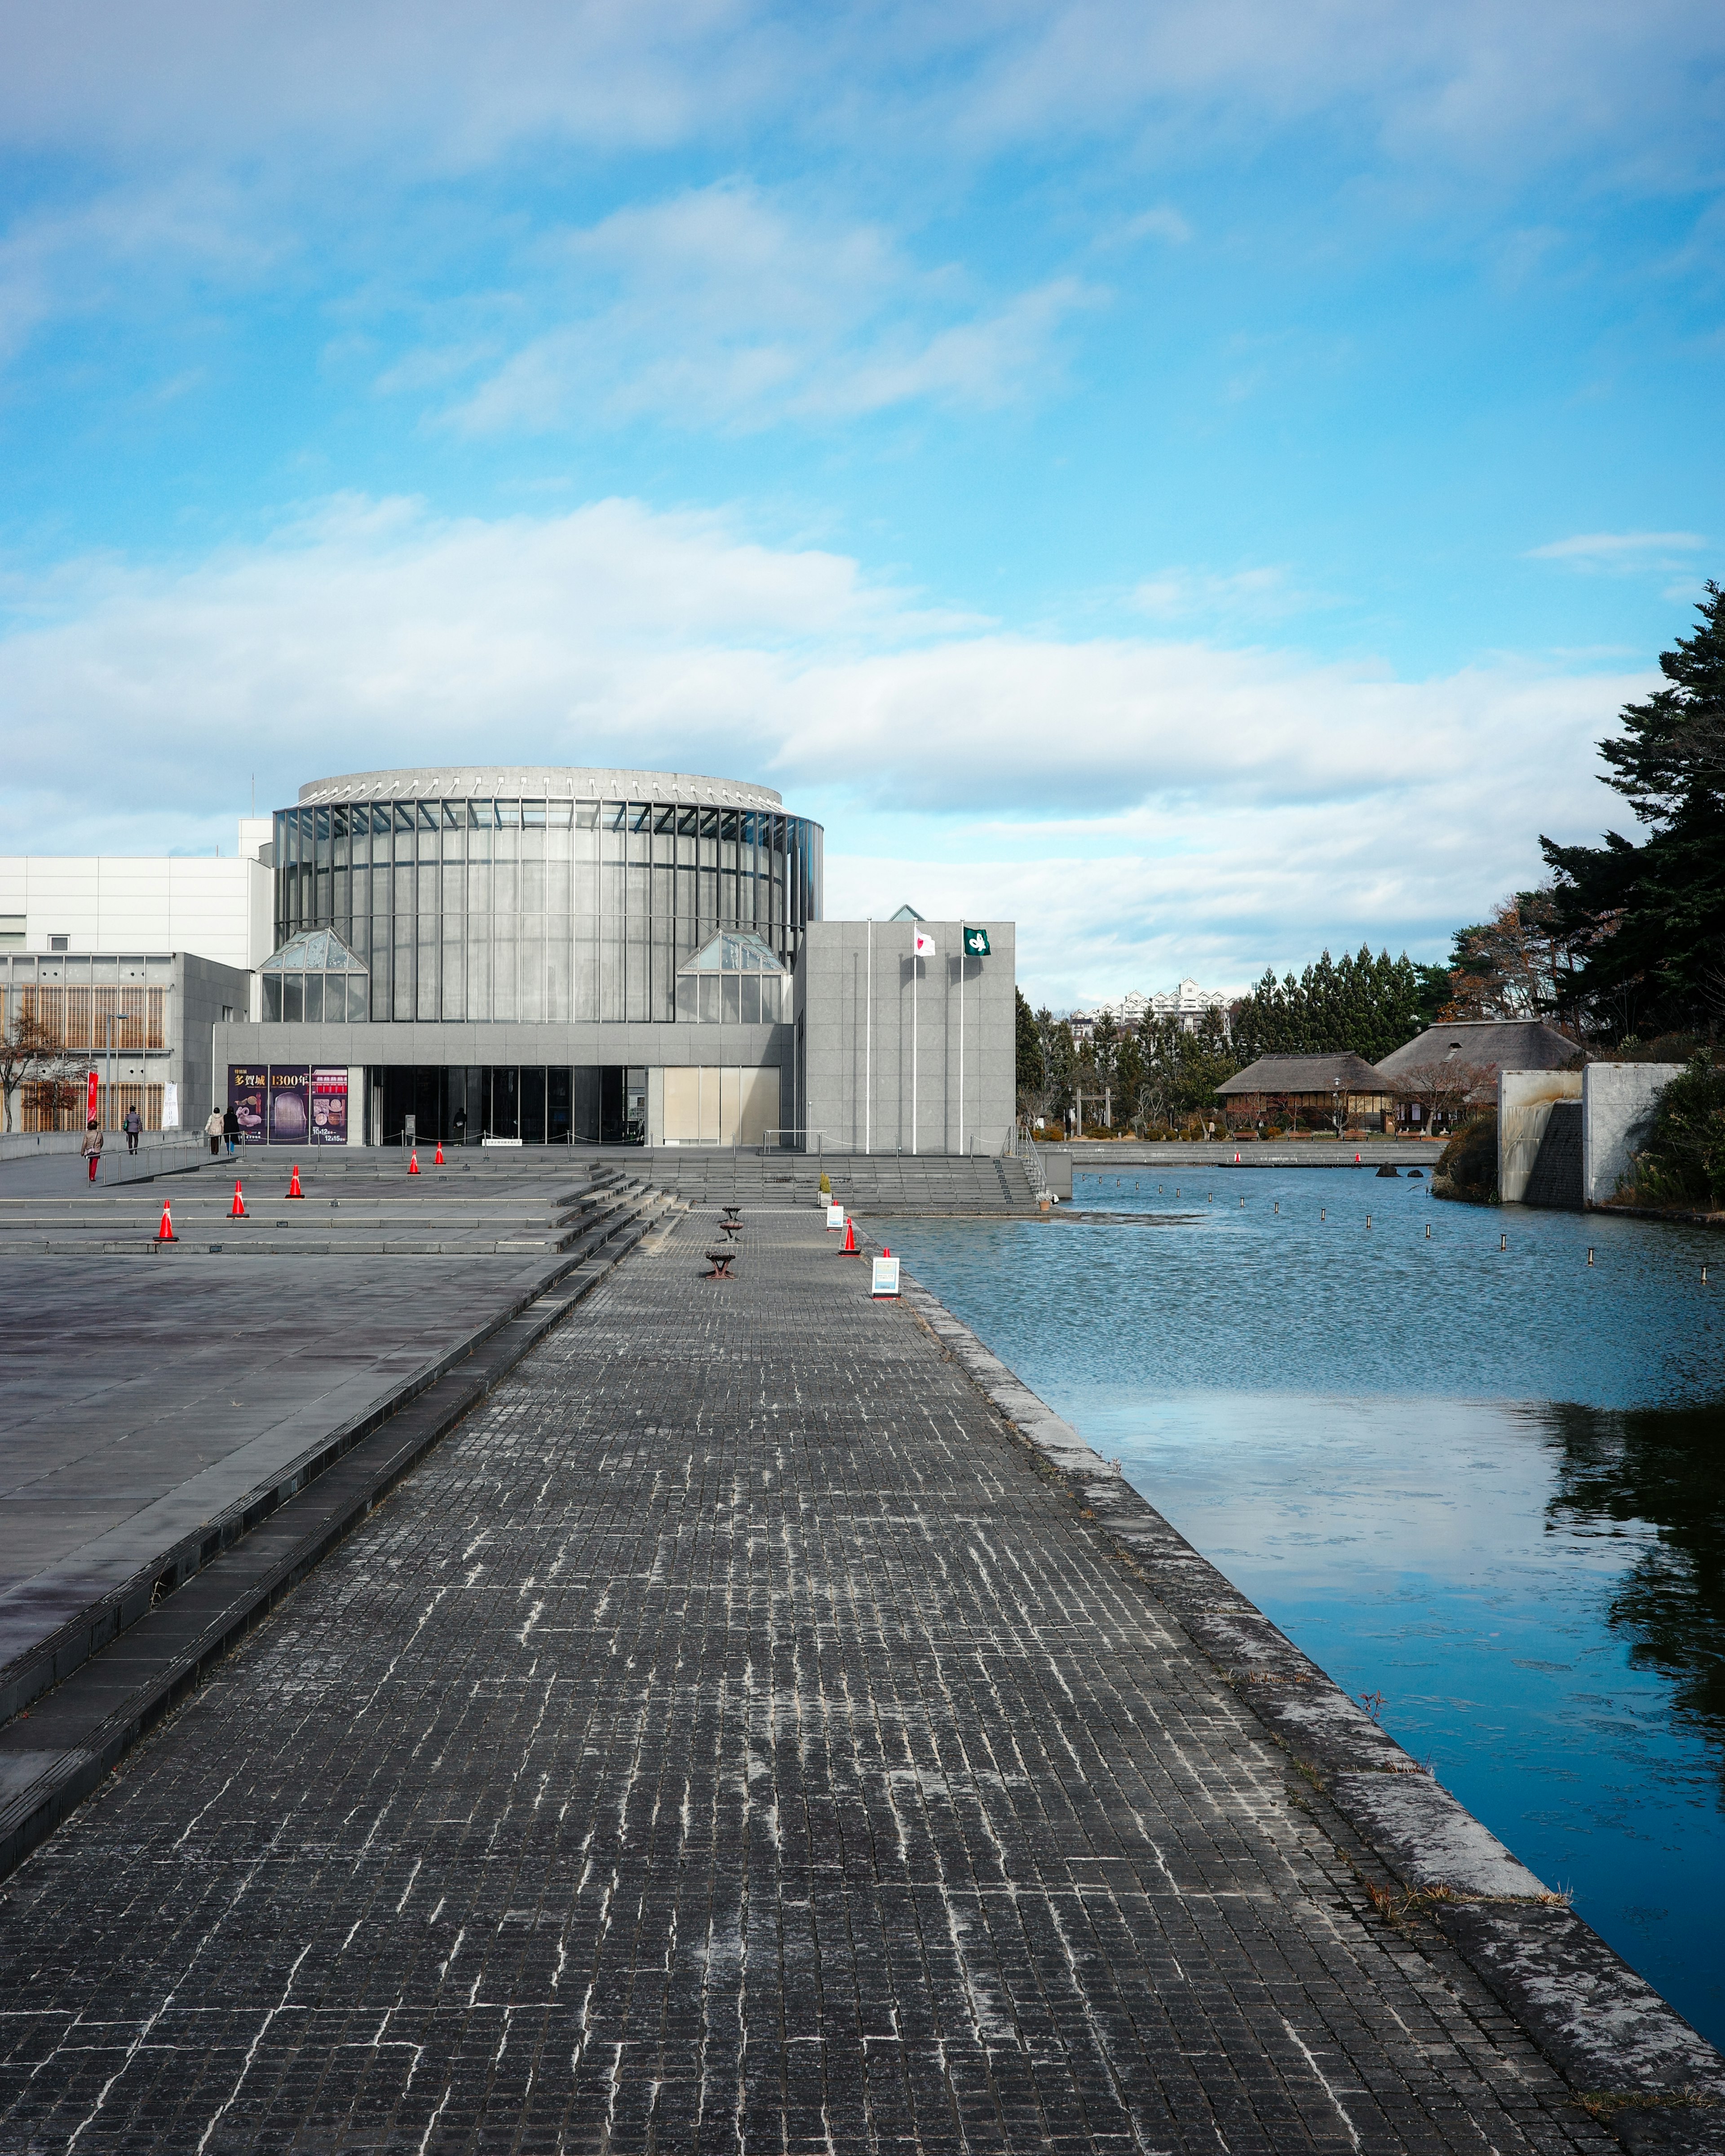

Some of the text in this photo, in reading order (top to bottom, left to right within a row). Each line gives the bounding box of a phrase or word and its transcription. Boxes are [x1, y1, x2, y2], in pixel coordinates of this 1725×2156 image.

[234, 1074, 309, 1086] 多賀城 1300年
